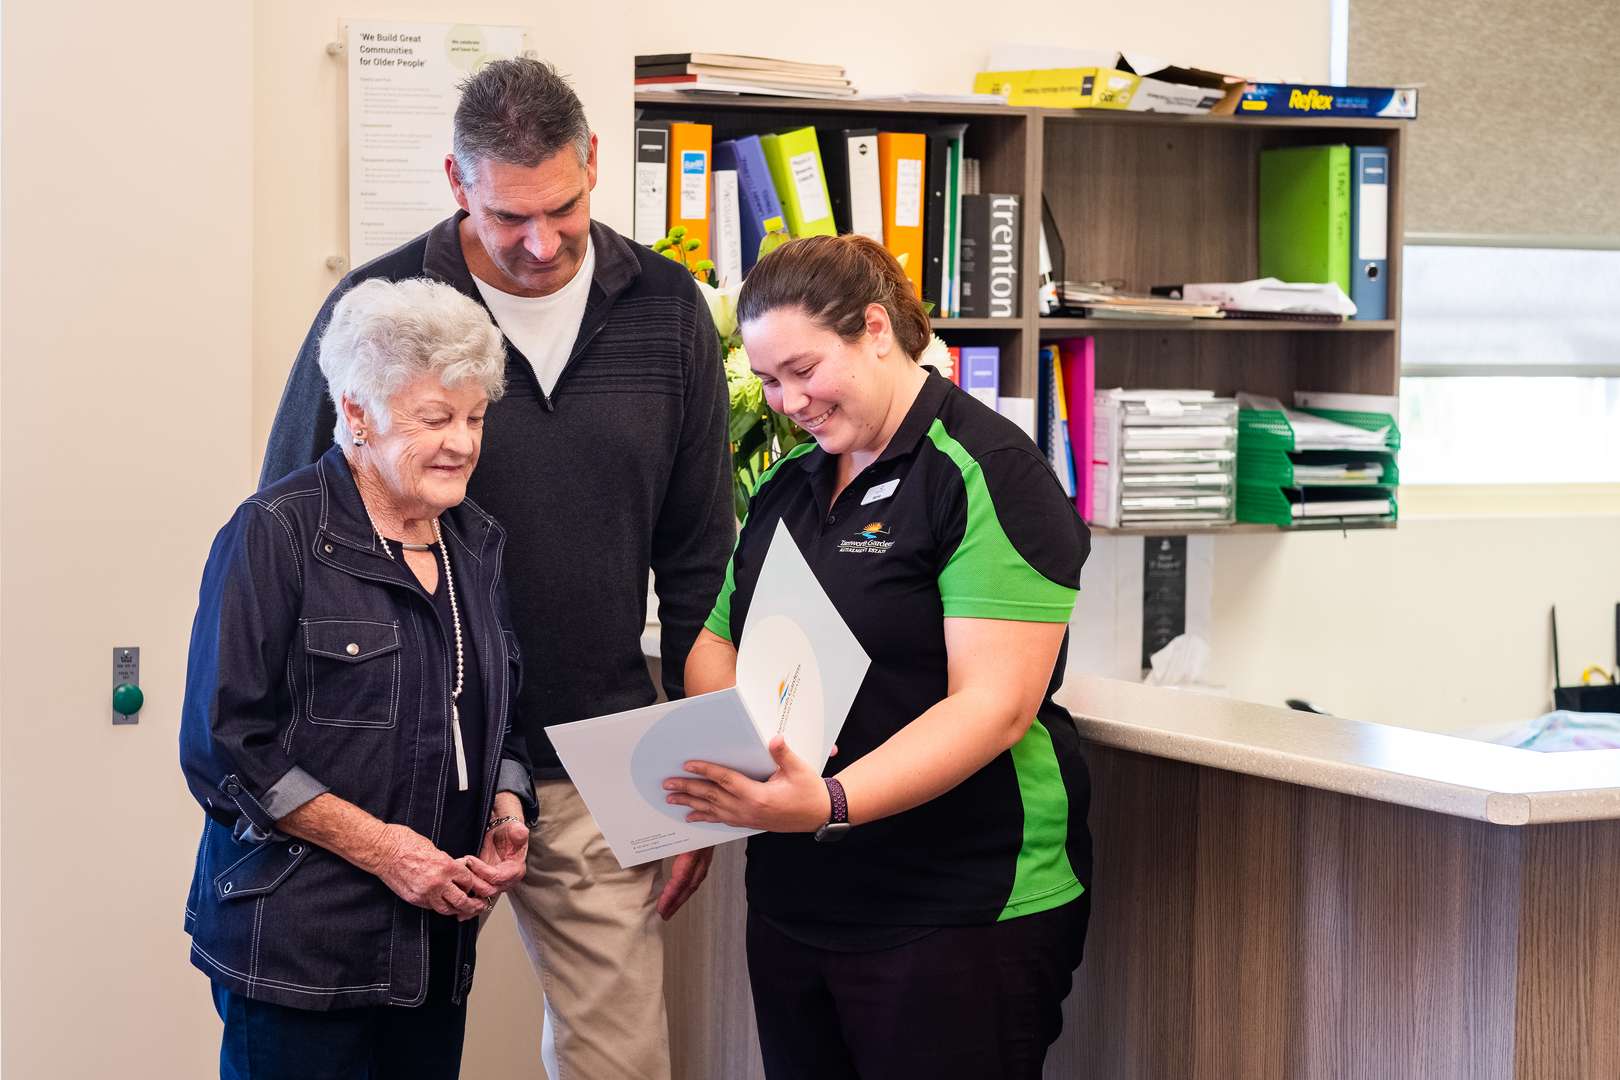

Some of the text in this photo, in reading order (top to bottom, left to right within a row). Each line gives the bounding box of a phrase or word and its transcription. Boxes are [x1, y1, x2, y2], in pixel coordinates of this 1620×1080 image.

[377, 33, 398, 42] Build
[400, 34, 421, 42] Great
[359, 45, 413, 54] Communities
[359, 57, 371, 66] for
[373, 58, 395, 66] Older
[1289, 89, 1333, 111] Reflex
[991, 196, 1018, 317] trenton
